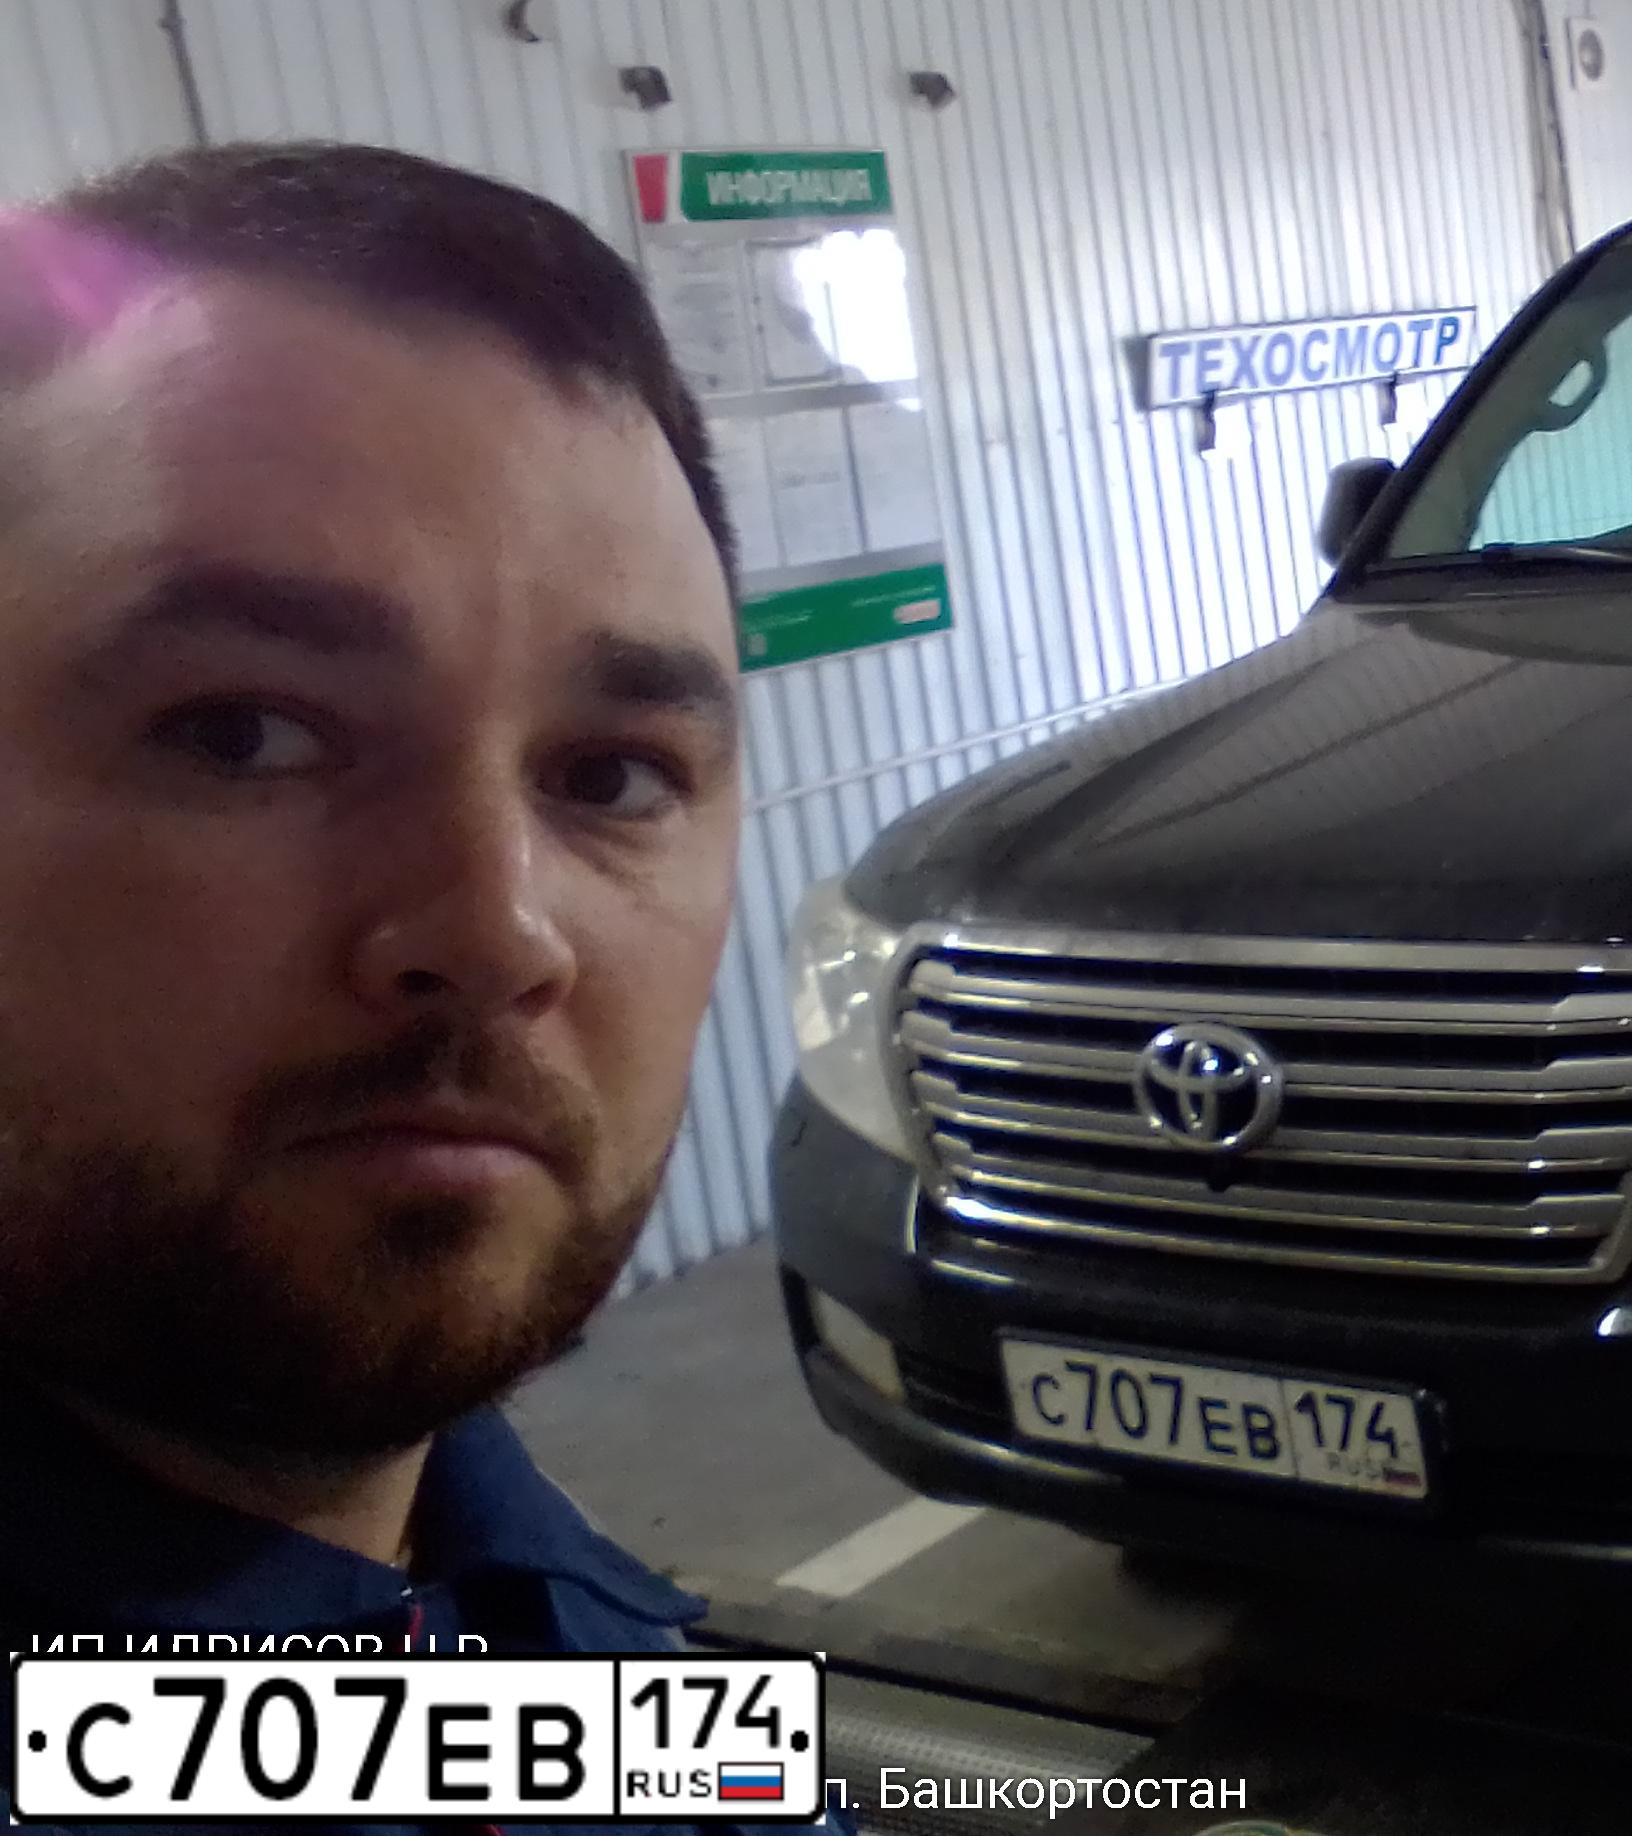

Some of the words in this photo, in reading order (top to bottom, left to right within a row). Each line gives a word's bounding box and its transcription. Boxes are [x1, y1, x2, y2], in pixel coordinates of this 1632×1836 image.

[705, 168, 873, 207] ИНФОРМАЦИЯ
[1158, 316, 1460, 399] ТЕХОСМОТР
[1031, 1359, 1281, 1461] С707ЕВ
[1294, 1390, 1398, 1459] 174
